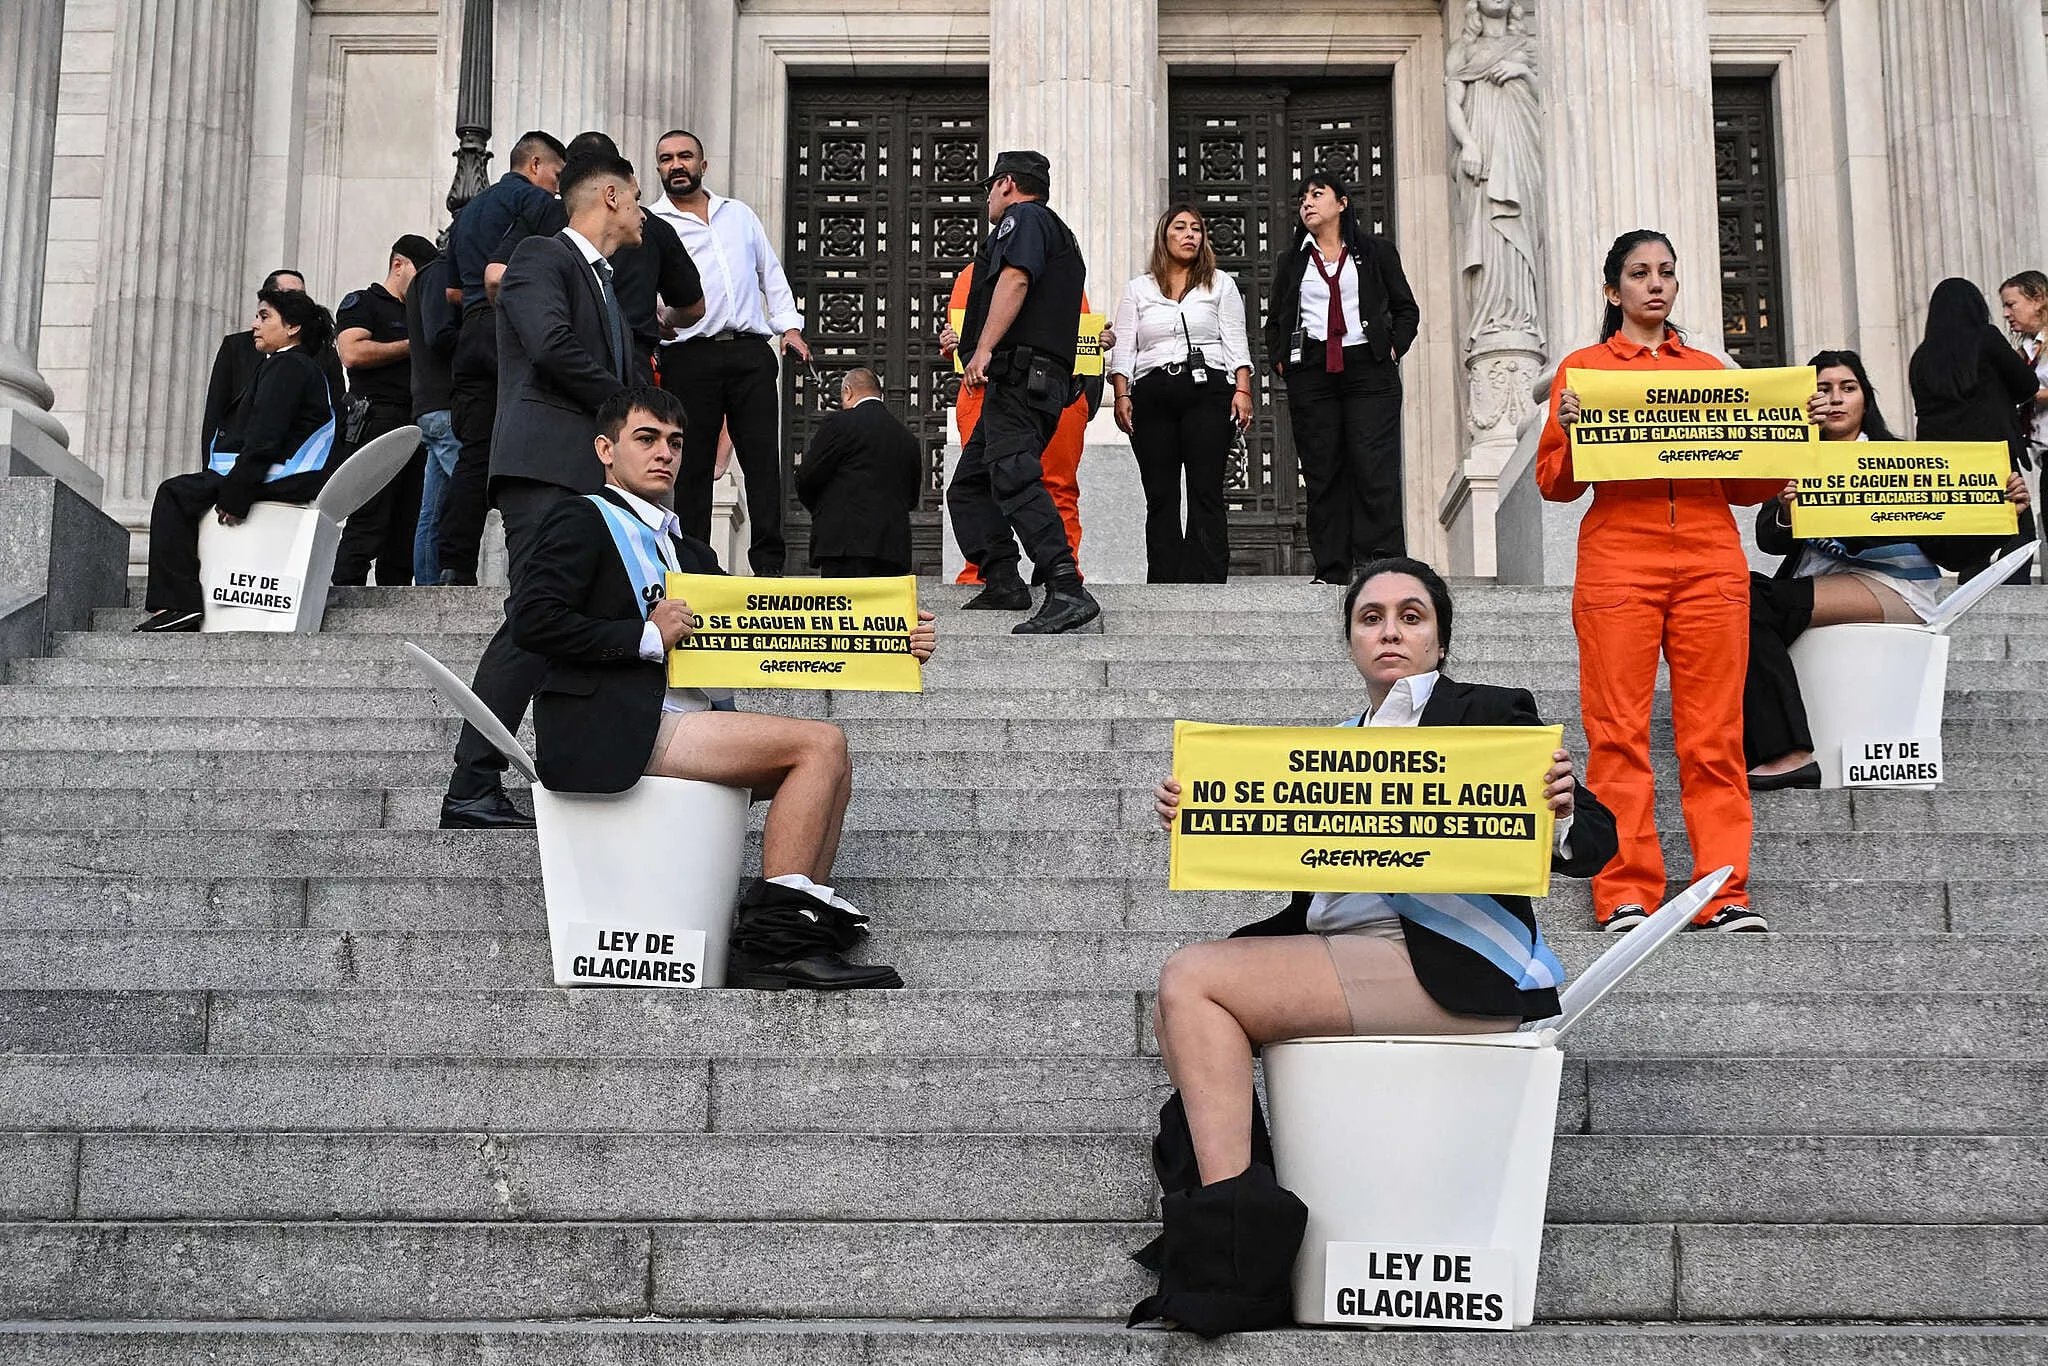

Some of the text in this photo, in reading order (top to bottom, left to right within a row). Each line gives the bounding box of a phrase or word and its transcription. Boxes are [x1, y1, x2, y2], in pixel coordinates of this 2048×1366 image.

[1077, 336, 1097, 344] GUA
[1646, 388, 1749, 405] SENADORES:
[1581, 407, 1803, 424] NO SE CAGUEN EN EL AGUA
[1581, 427, 1804, 442] LA LEY DE GLACIARES NO SE TOCA
[1658, 450, 1743, 463] GREENPEACE
[1858, 457, 1949, 470] SENADORES:
[1827, 475, 1845, 488] SE
[1850, 475, 1908, 488] CAGUEN
[1913, 475, 1932, 488] EN
[1937, 474, 1954, 487] EL
[1958, 473, 1998, 487] AGUA
[1802, 491, 2000, 505] LA LEY DE GLACIARES NO SE TOCA
[1871, 511, 1946, 523] GREENPEACE
[230, 573, 280, 591] LEY DE
[213, 587, 292, 609] GLACIARES
[746, 595, 852, 611] SENADORES:
[691, 615, 908, 632] O SE CAGUEN EN EL AGUA
[682, 636, 908, 652] LA LEY DE GLACIARES NO SE TOCA
[760, 660, 846, 673] GREENPEACE
[1865, 742, 1919, 760] LEY DE
[1288, 750, 1446, 774] SENADORES:
[1849, 763, 1937, 782] GLACIARES
[1193, 781, 1527, 807] NO SE CAGUEN EN EL AGUA
[1190, 813, 1527, 837] LA LEY DE GLACIARES NO SE TOCA
[1300, 849, 1431, 868] GREENPEACE
[598, 930, 675, 955] LEY DE
[573, 955, 696, 983] GLACIARES
[1368, 1252, 1471, 1283] LEY DE
[1337, 1287, 1503, 1322] GLACIARES
